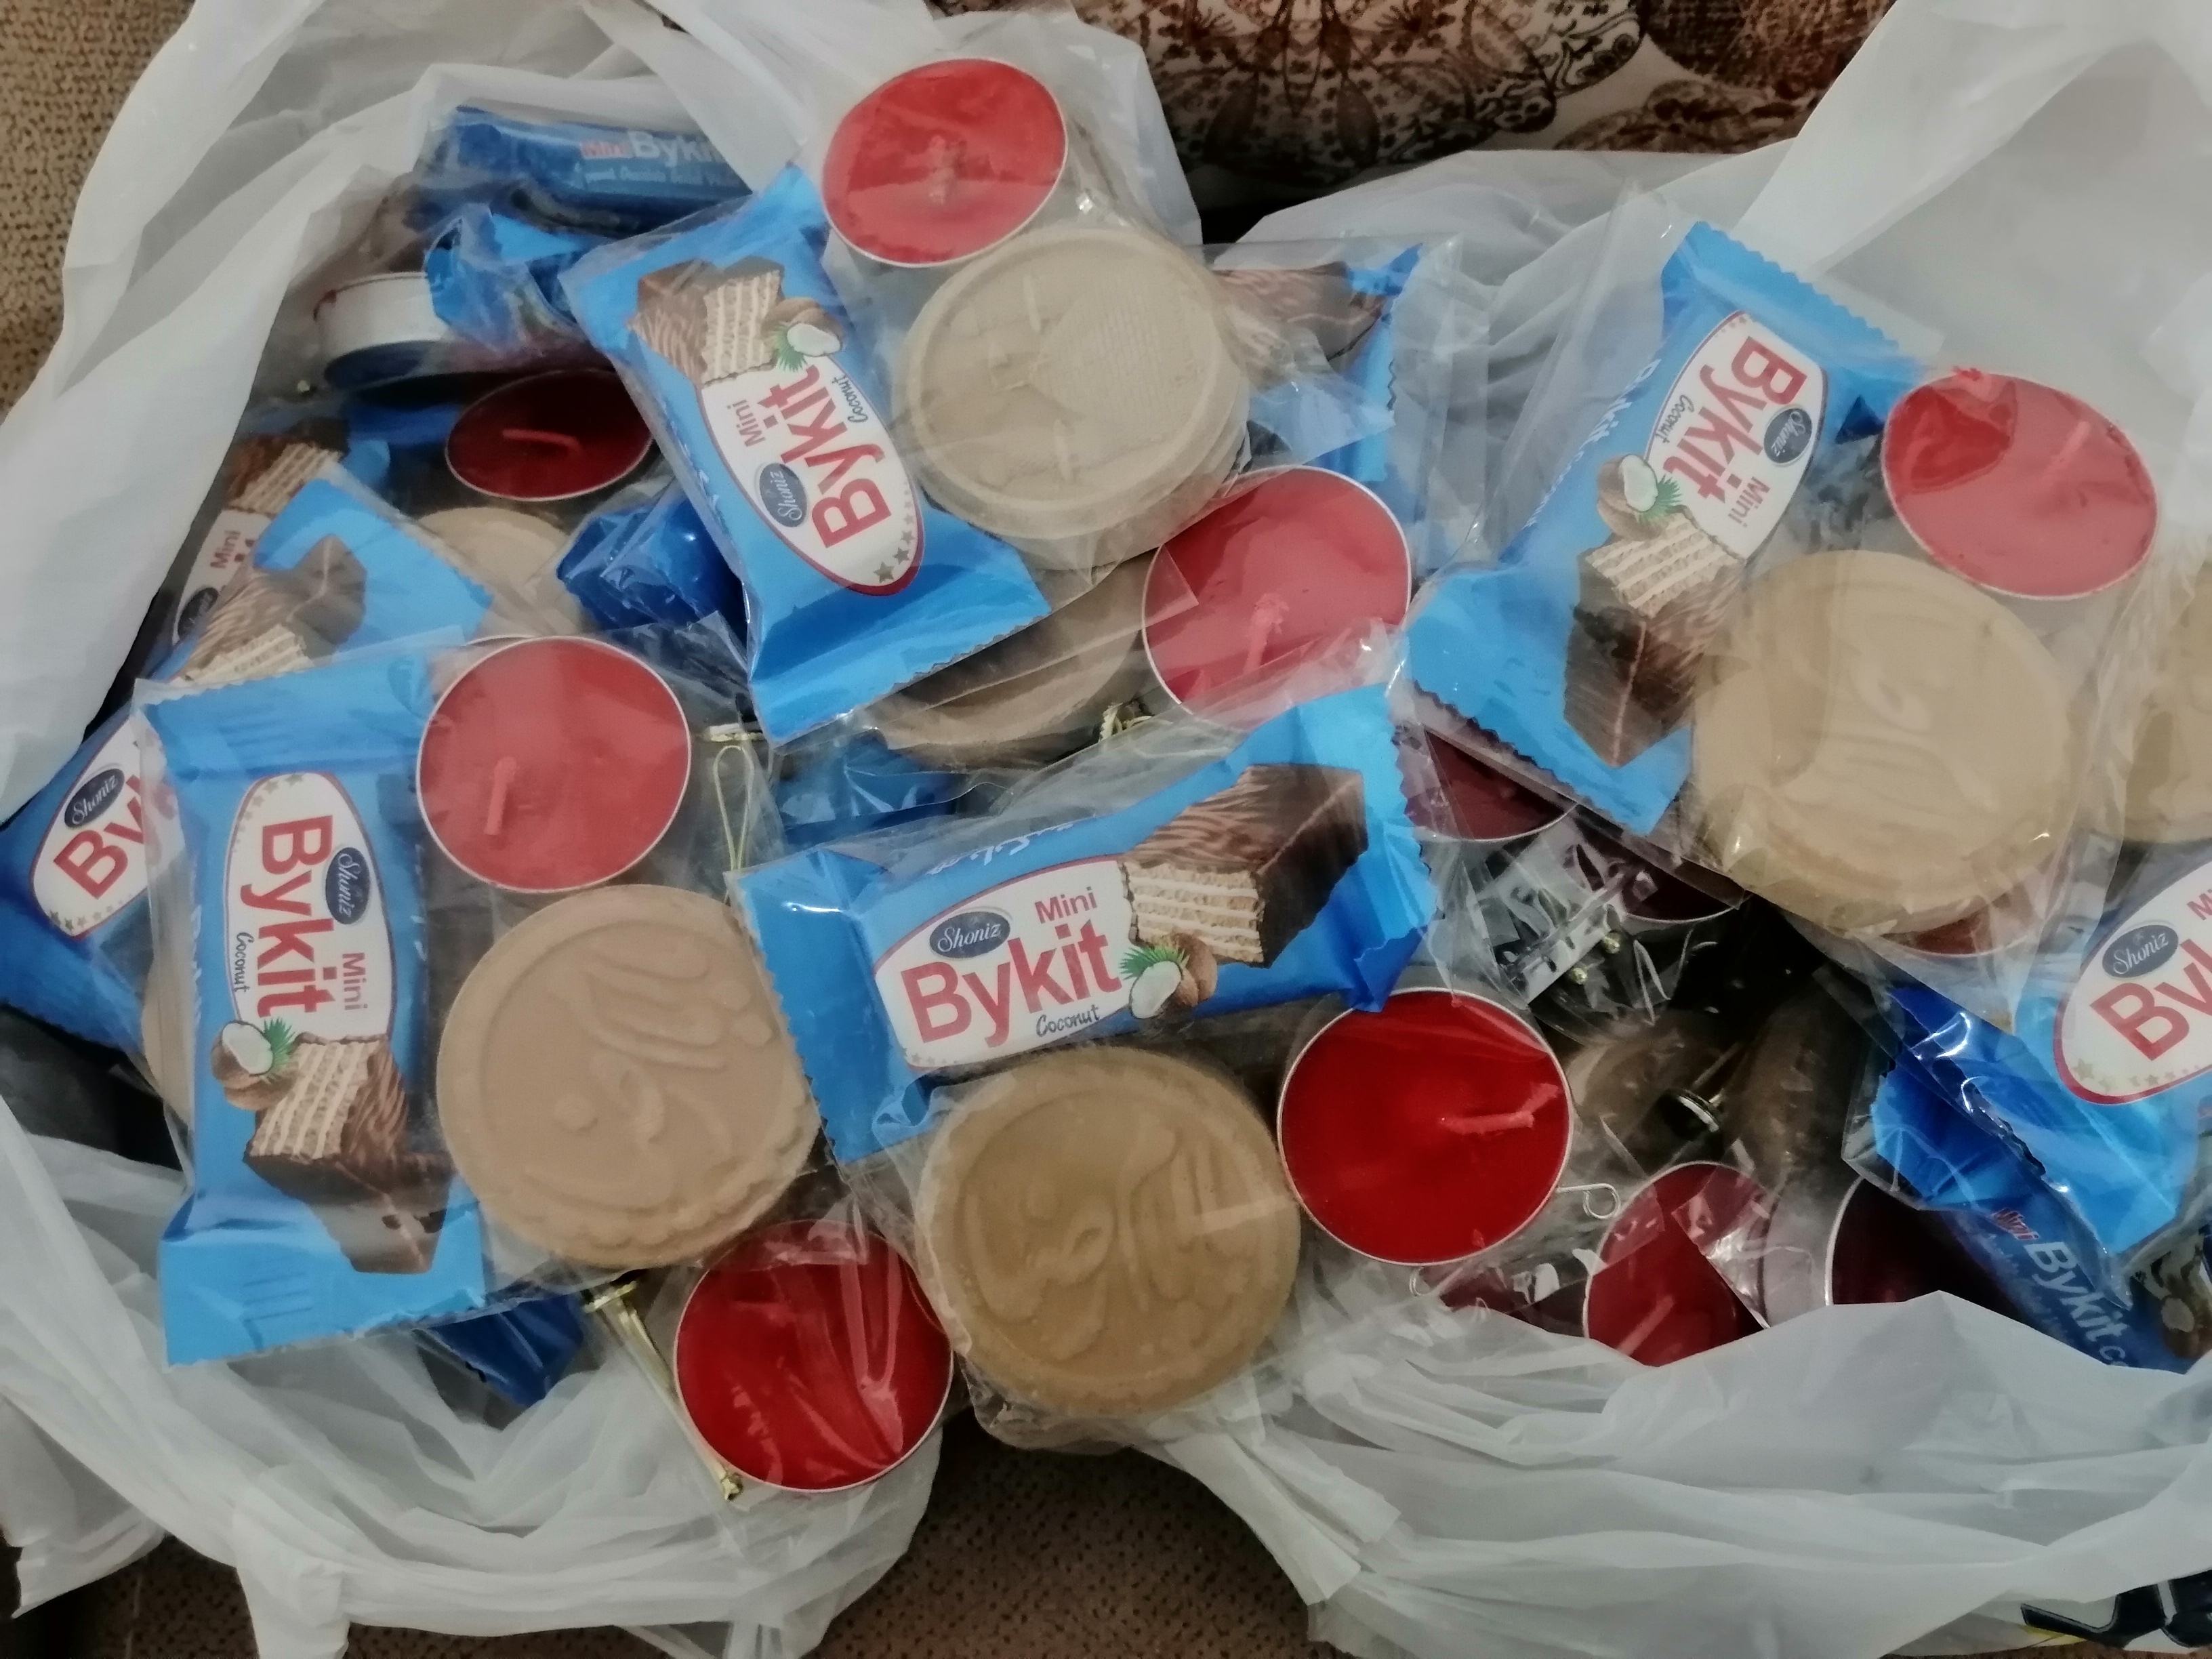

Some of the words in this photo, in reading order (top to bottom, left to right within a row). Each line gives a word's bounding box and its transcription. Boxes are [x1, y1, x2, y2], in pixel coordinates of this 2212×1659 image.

[727, 399, 766, 447] Mini
[832, 374, 869, 424] Coconut
[1656, 394, 1695, 444] Coconut
[1663, 335, 1807, 504] Bykit
[758, 365, 893, 549] Bykit
[1770, 411, 1806, 457] Shoniz
[769, 470, 804, 521] Shoniz
[1728, 476, 1771, 528] Mini
[209, 529, 241, 569] Mini
[72, 774, 119, 825] Shoniz
[337, 853, 363, 917] Shoniz
[1034, 886, 1098, 924] Mini
[240, 815, 336, 1018] Bykit
[937, 921, 1003, 953] Shoniz
[234, 931, 254, 994] Coconut
[2112, 931, 2169, 975] Shoniz
[342, 952, 368, 1010] Mini
[900, 919, 1122, 1048] Bykit
[1036, 1004, 1100, 1038] Coconut
[2024, 1242, 2130, 1343] Bykit
